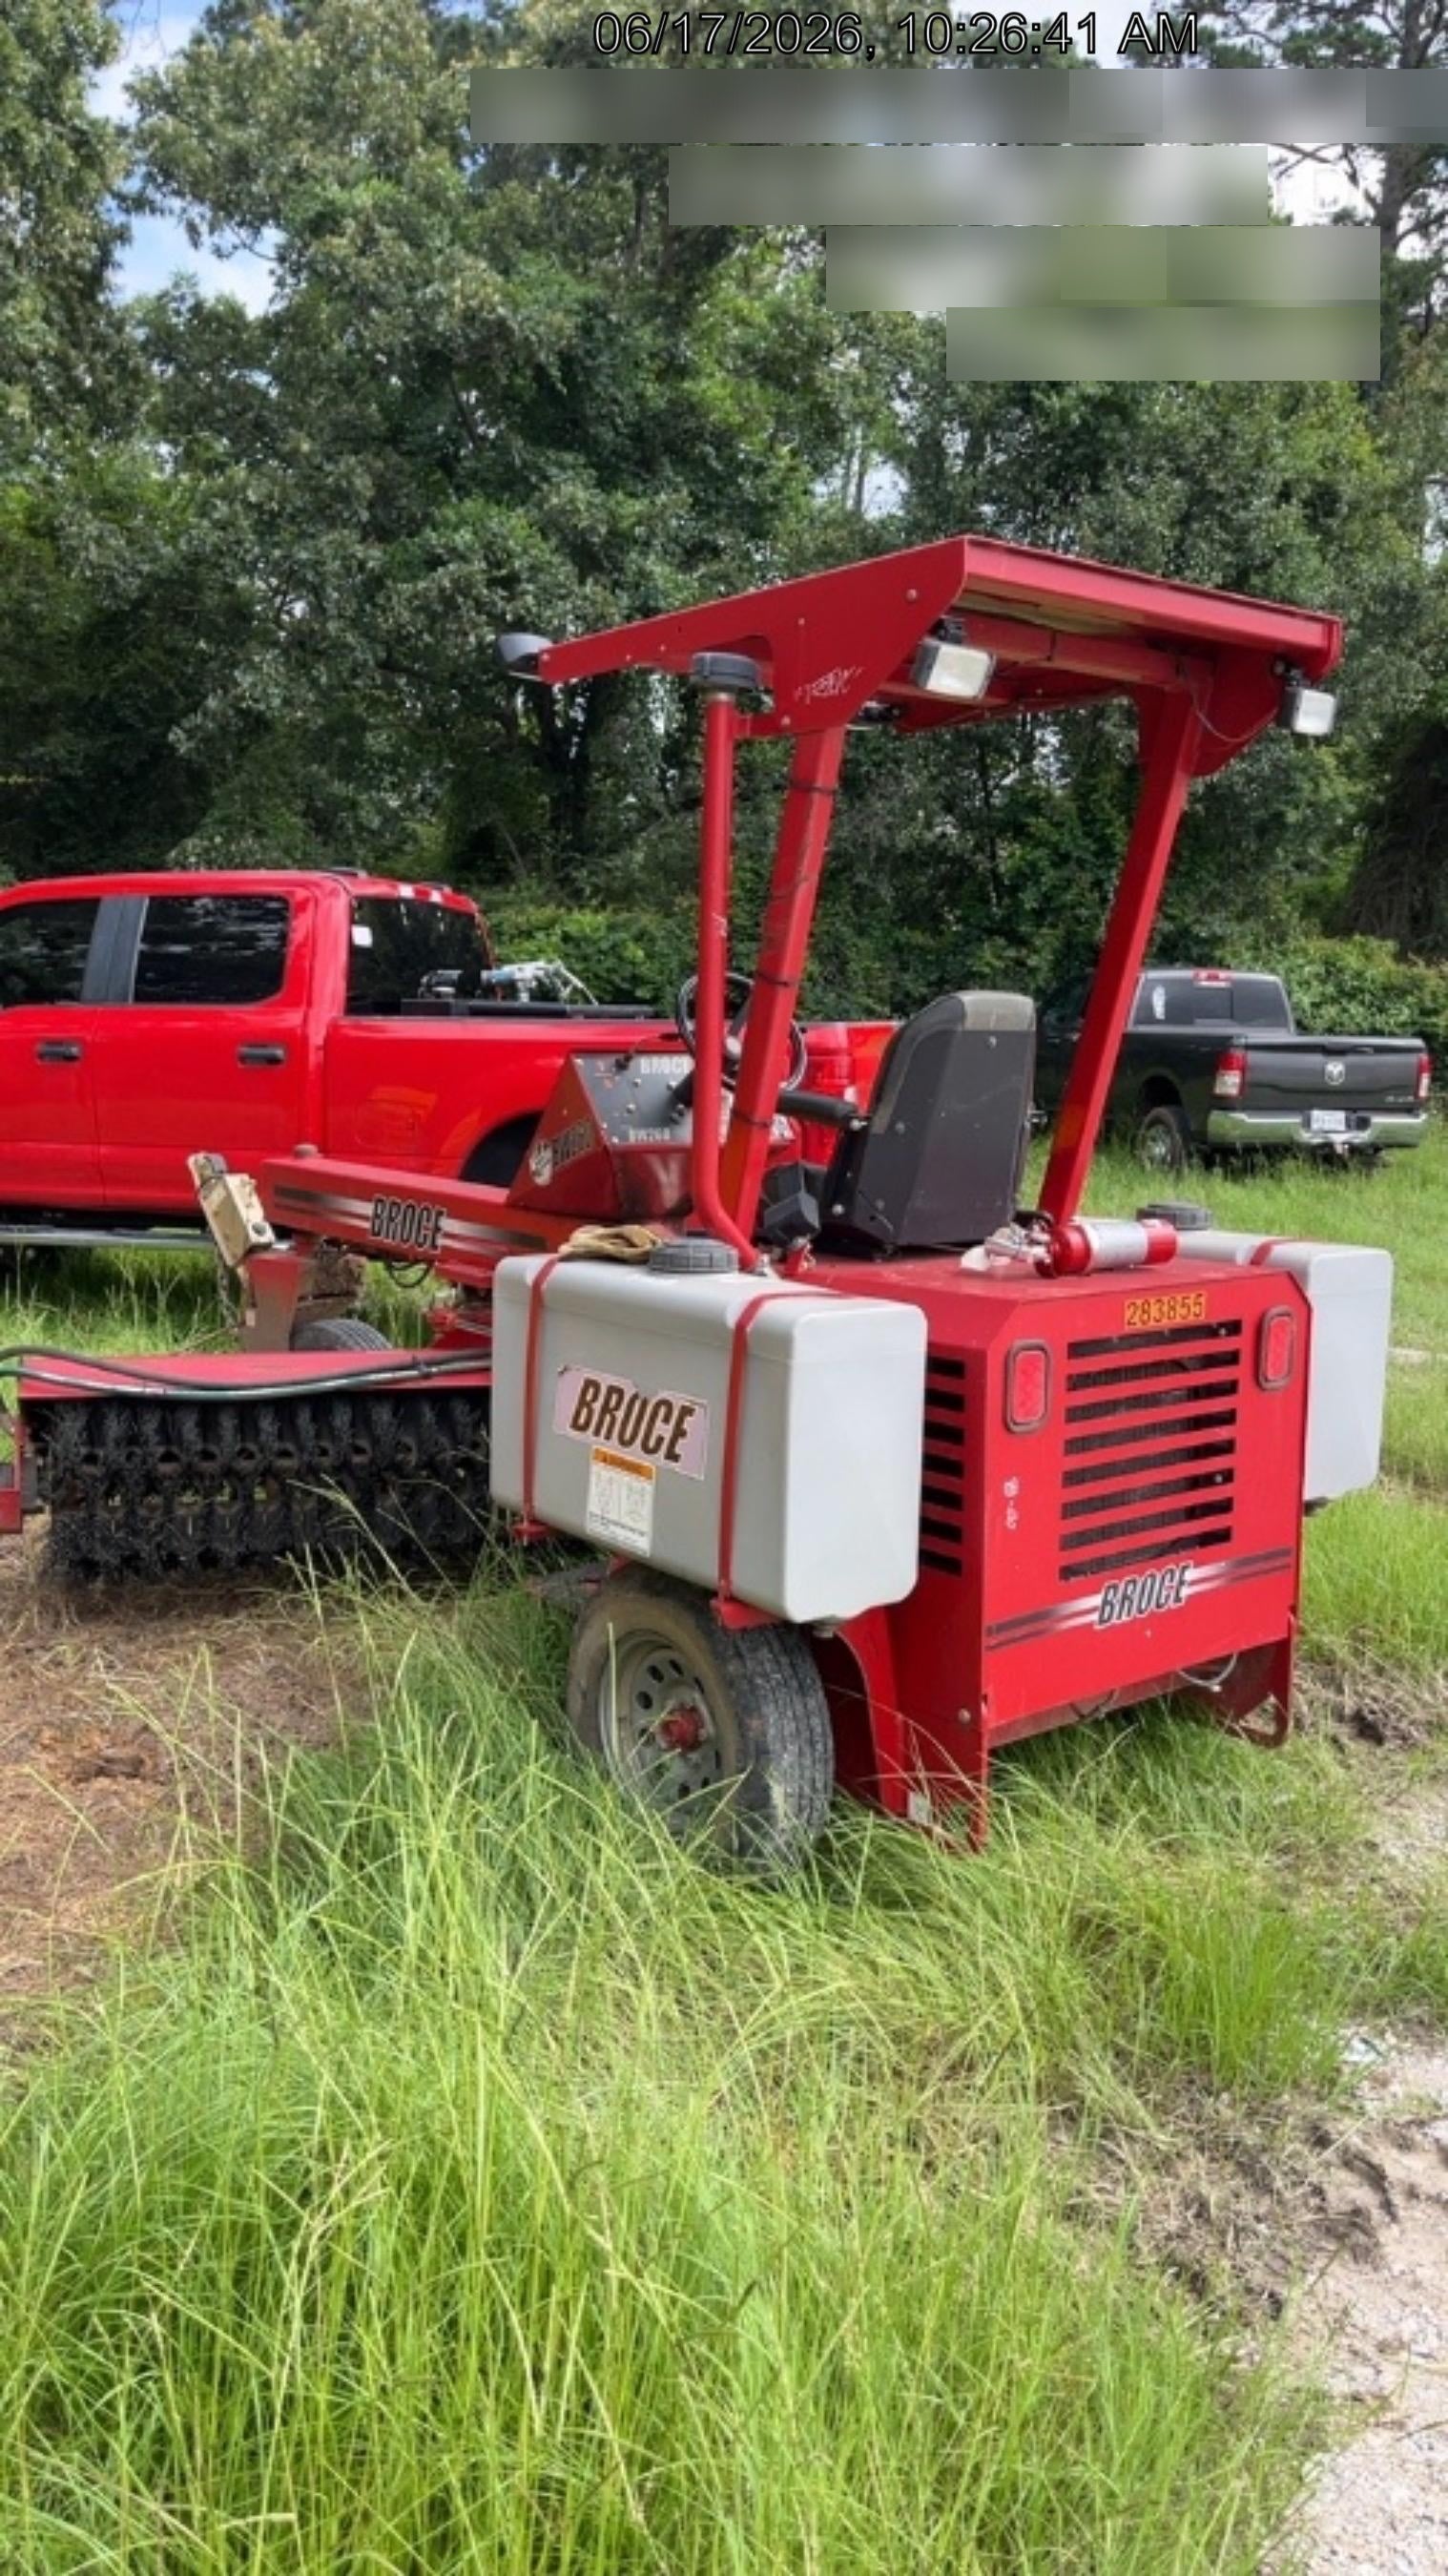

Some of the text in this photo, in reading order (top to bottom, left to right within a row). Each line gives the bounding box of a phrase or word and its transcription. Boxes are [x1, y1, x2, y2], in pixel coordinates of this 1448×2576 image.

[371, 1195, 446, 1253] BROCE
[1127, 1293, 1204, 1326] 283855
[1097, 1563, 1192, 1628] BROCE
